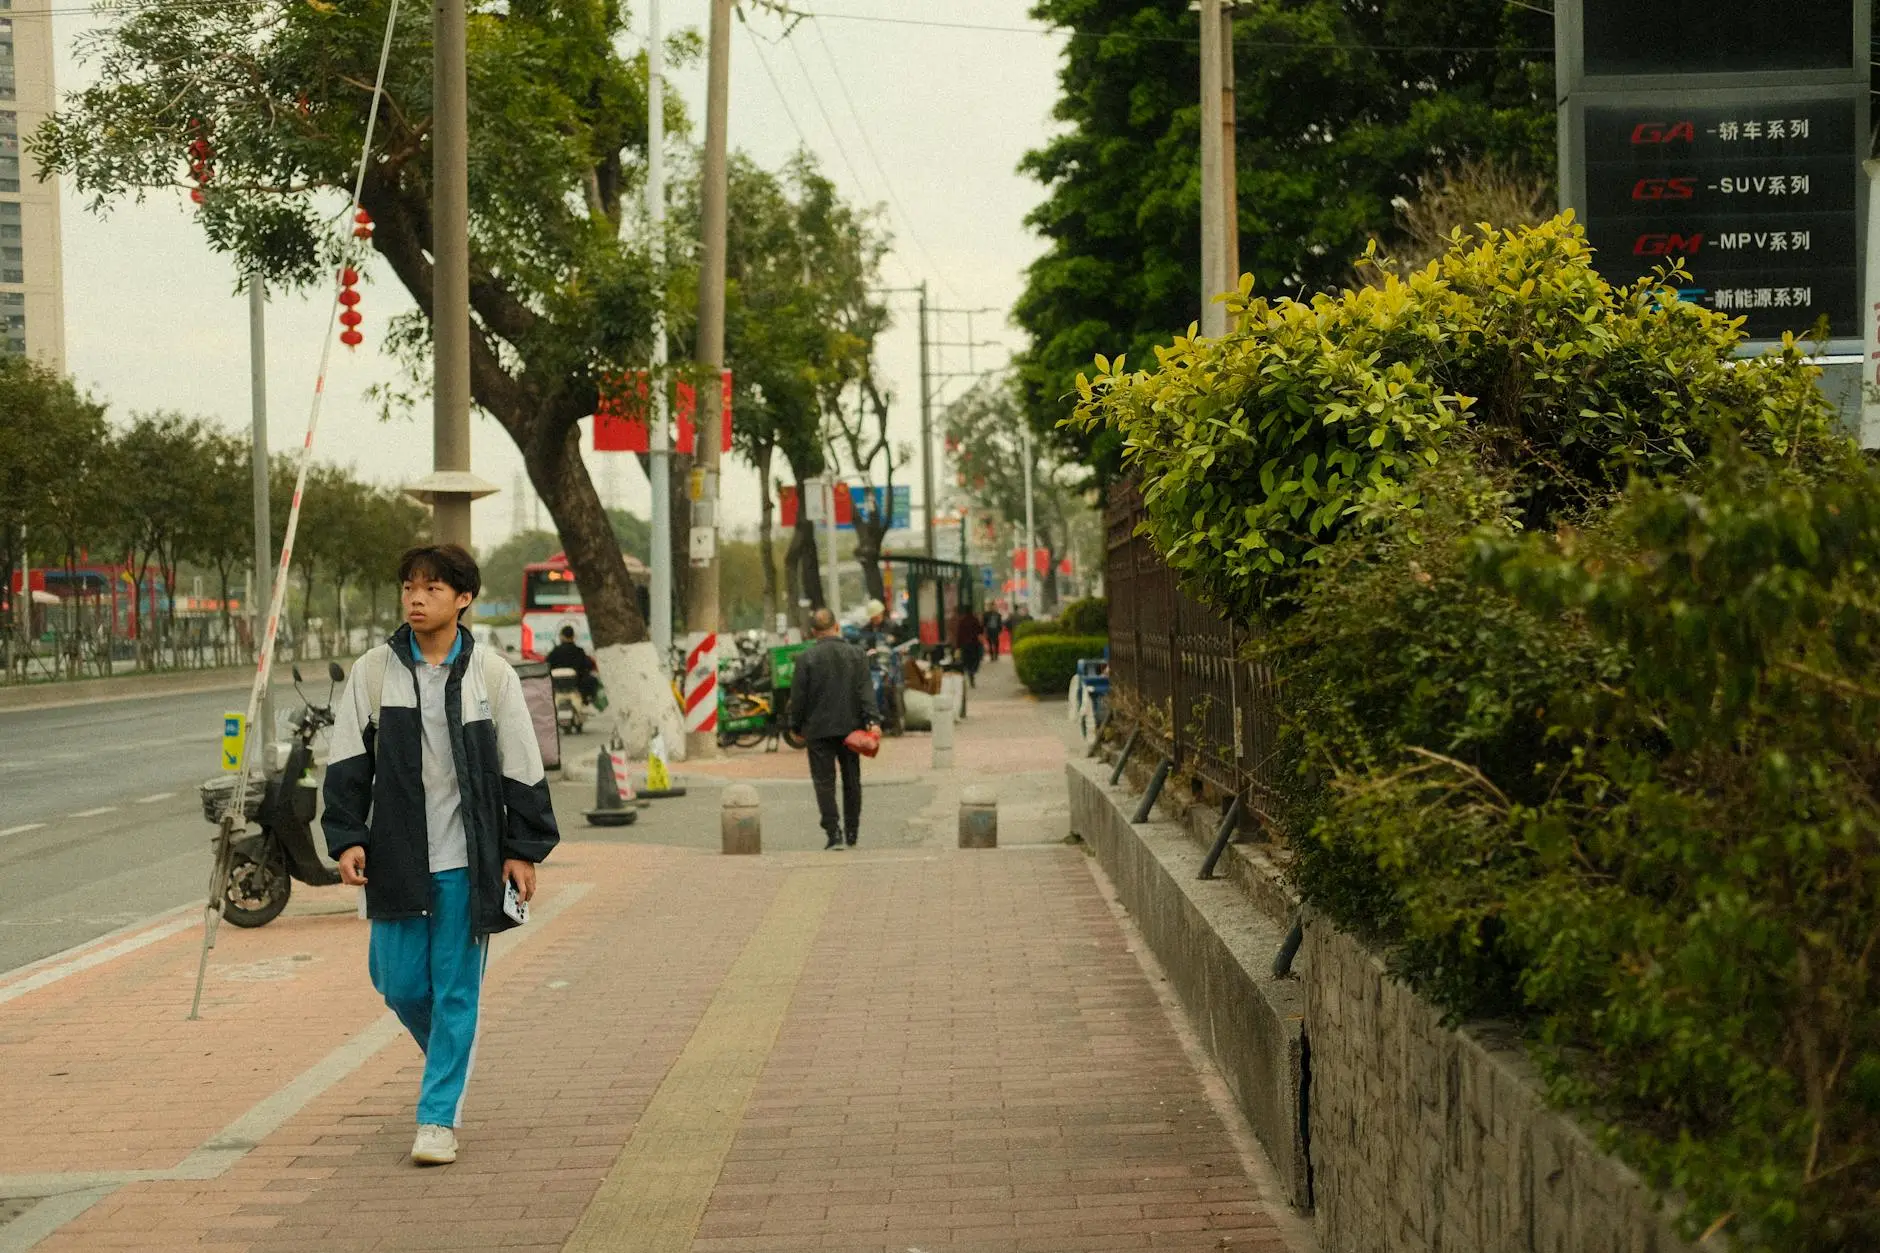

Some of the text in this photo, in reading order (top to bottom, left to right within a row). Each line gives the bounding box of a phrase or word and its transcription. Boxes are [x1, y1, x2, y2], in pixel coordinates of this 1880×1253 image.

[1631, 121, 1695, 144] GA
[1632, 178, 1699, 200] GS
[1633, 233, 1703, 256] GM
